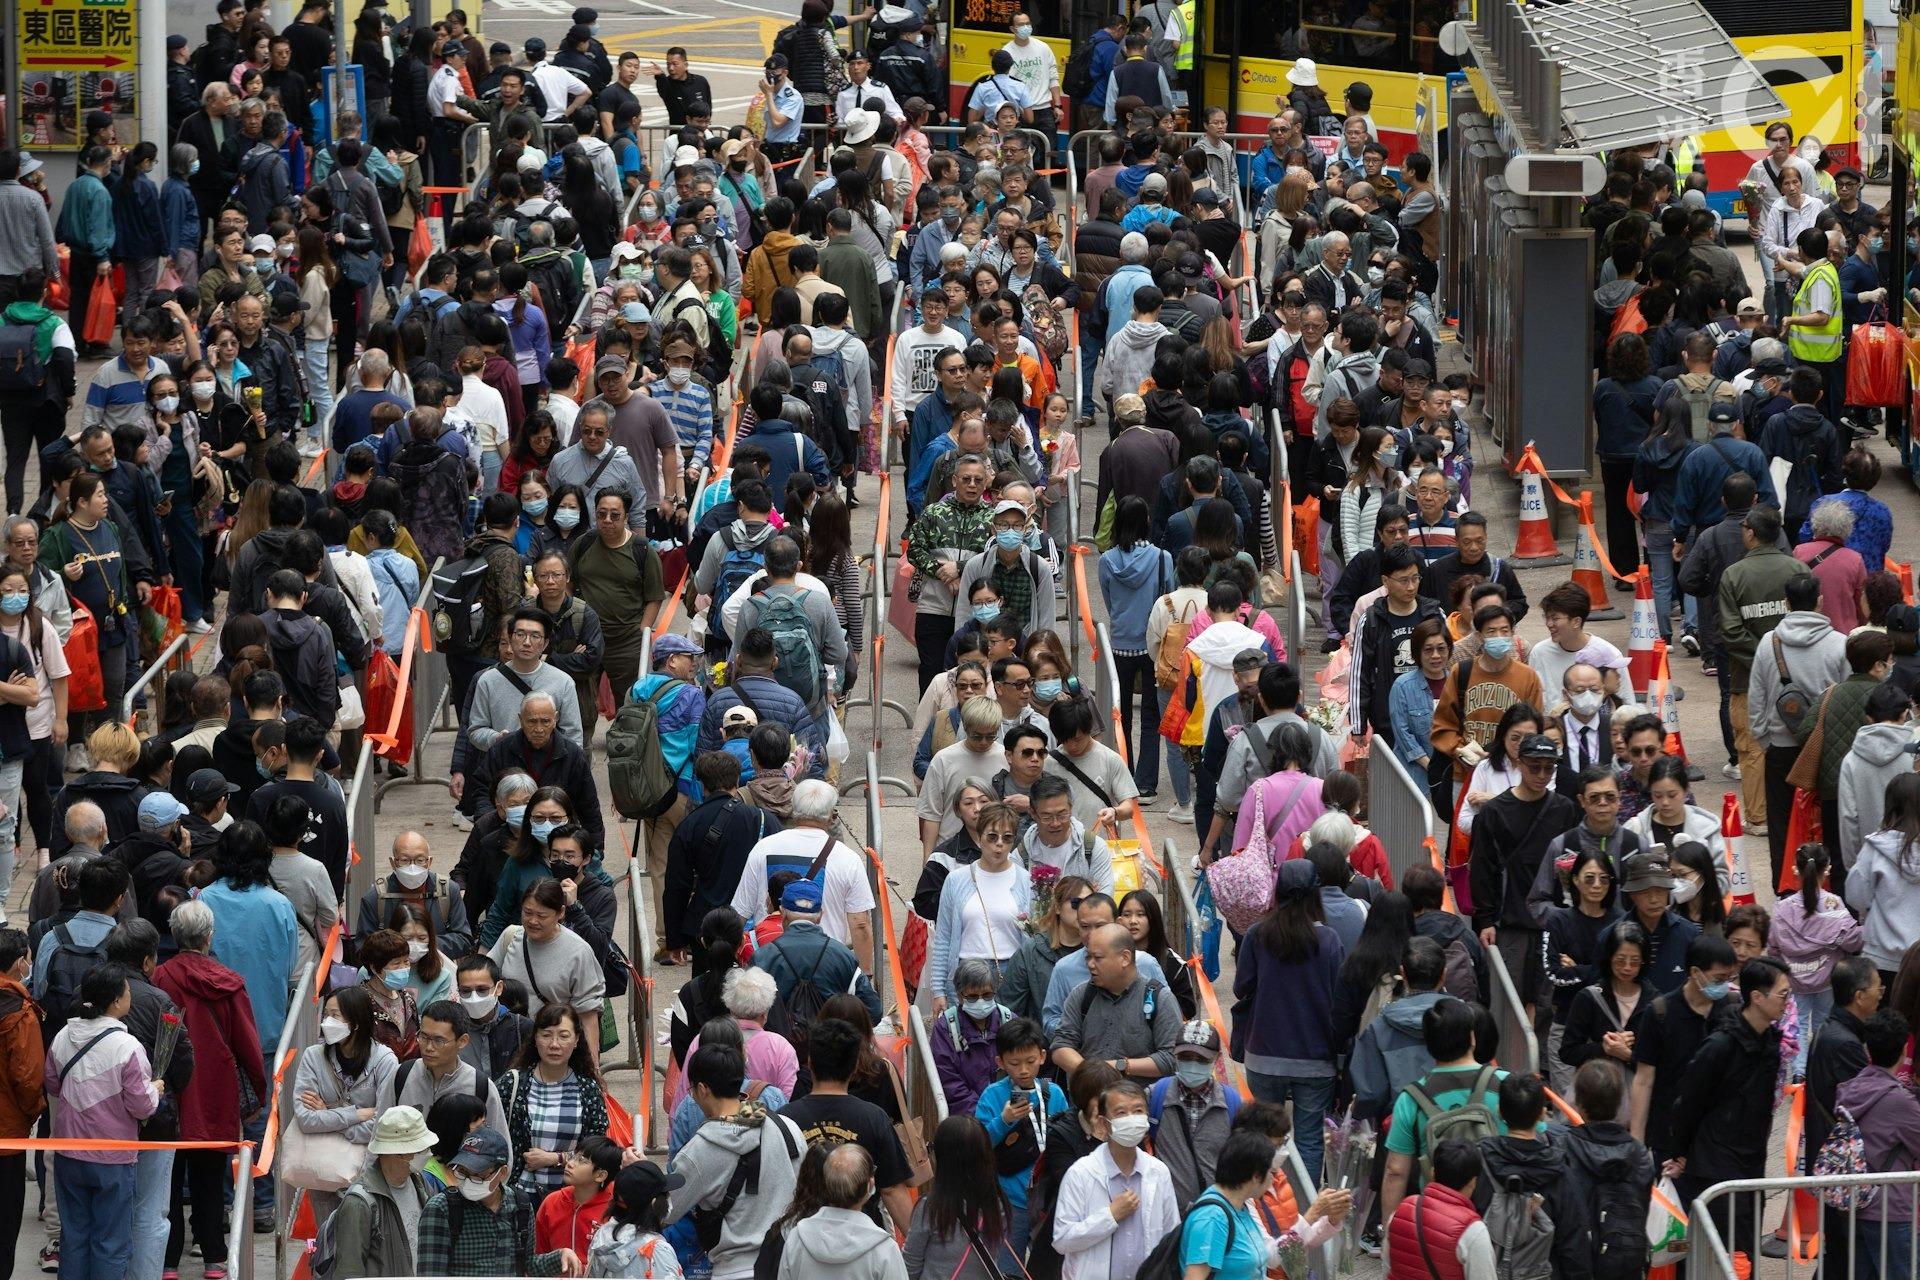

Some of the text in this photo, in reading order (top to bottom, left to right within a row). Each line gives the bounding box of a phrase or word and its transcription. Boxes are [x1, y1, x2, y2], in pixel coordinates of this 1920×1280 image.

[23, 8, 132, 47] 東區醫院
[1013, 57, 1042, 68] Mardi
[1252, 72, 1277, 84] Citybus
